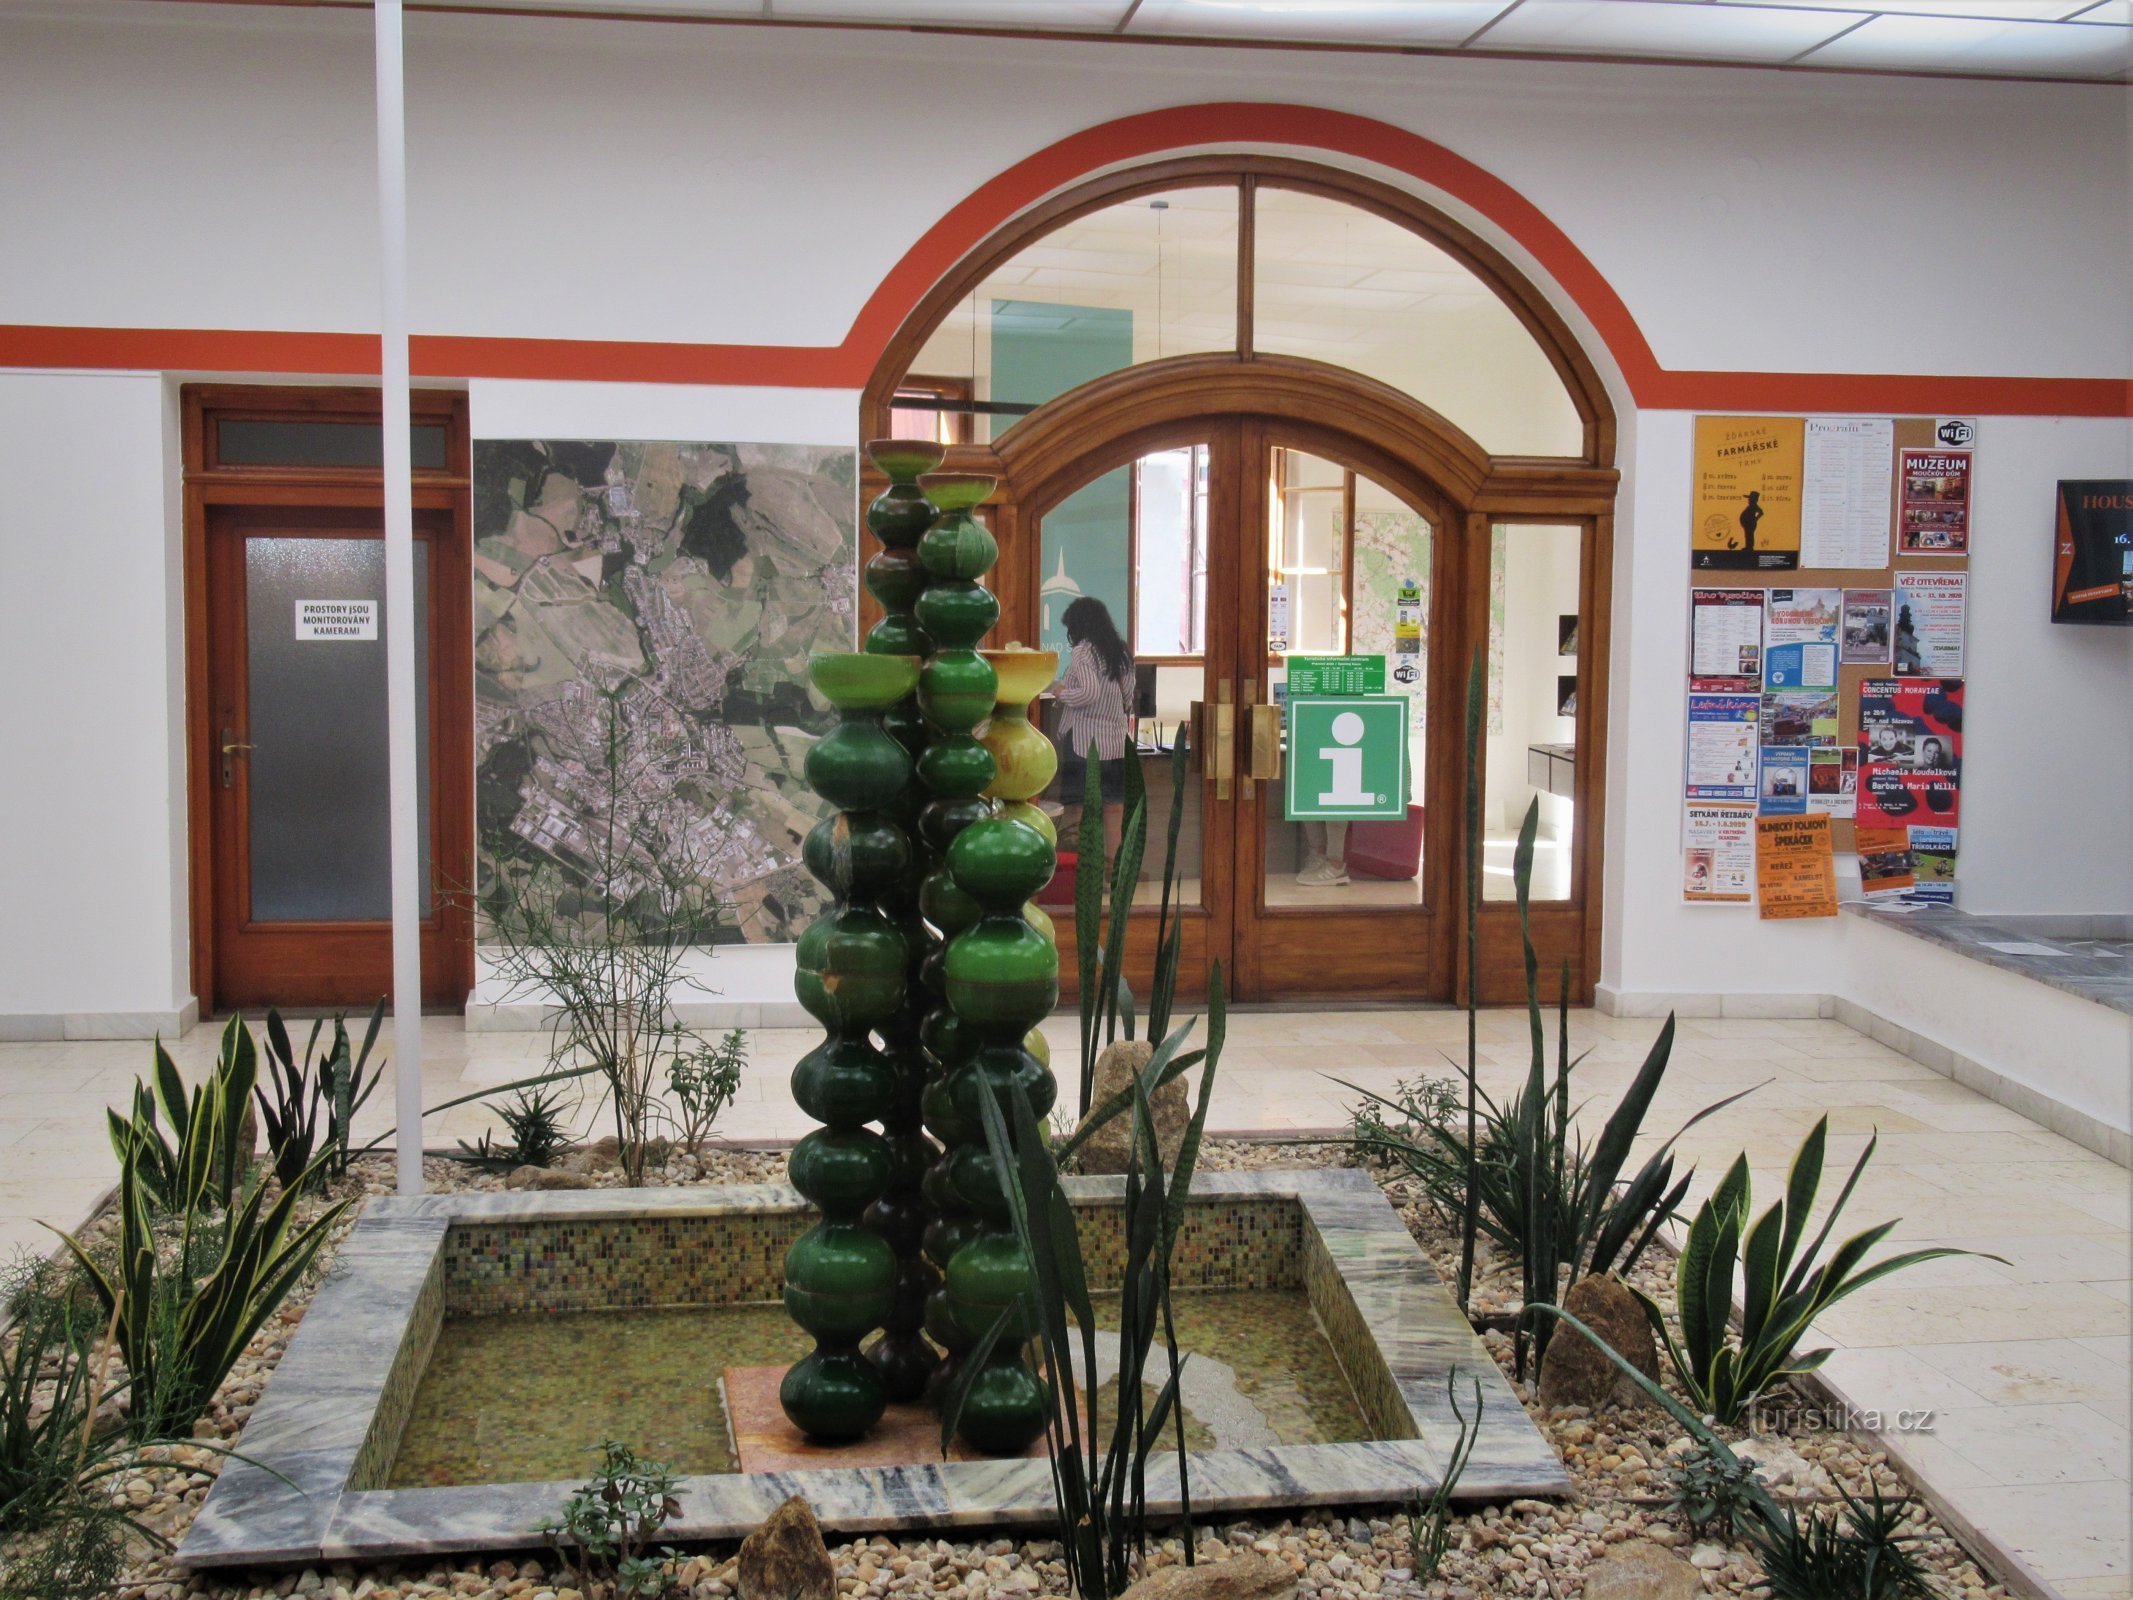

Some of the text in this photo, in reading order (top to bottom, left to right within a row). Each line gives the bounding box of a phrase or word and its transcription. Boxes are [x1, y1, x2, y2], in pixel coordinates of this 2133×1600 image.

[1810, 422, 1859, 433] Program
[1717, 438, 1779, 457] FARMÁŘSKÉ
[1906, 459, 1967, 470] MUZEUM
[2114, 534, 2131, 544] 16.
[1900, 577, 1963, 586] VĚŽ OTEVŘENA!
[304, 605, 369, 614] PROSTORY JSOU
[303, 615, 370, 624] MONITOROVÁNY
[313, 627, 360, 635] KAMERAMI
[1872, 767, 1957, 776] Michaela Koudelková
[1872, 782, 1904, 790] Barbara
[1934, 782, 1956, 791] Willi
[1689, 809, 1753, 819] SETKÁNÍ ŘEZBÁŘŮ
[1774, 832, 1813, 846] ŠPEKÁČEK
[1770, 861, 1793, 870] NEŘEZ
